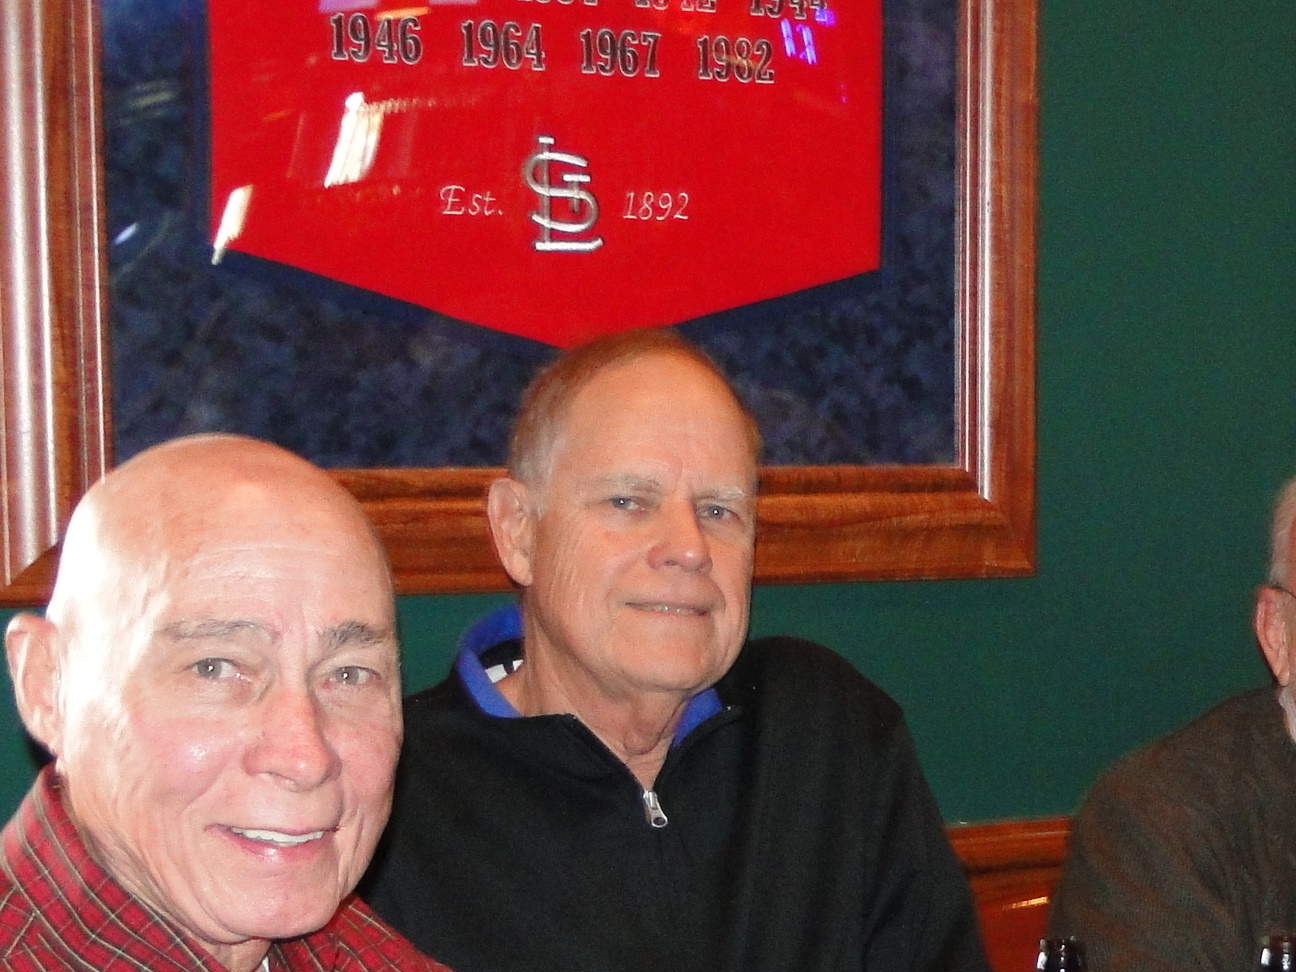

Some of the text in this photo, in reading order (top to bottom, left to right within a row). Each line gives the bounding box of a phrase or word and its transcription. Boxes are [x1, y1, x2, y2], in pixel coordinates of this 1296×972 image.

[331, 13, 775, 85] 1946 1964 1967 1982
[439, 185, 504, 217] Est.
[622, 190, 690, 221] 1892
